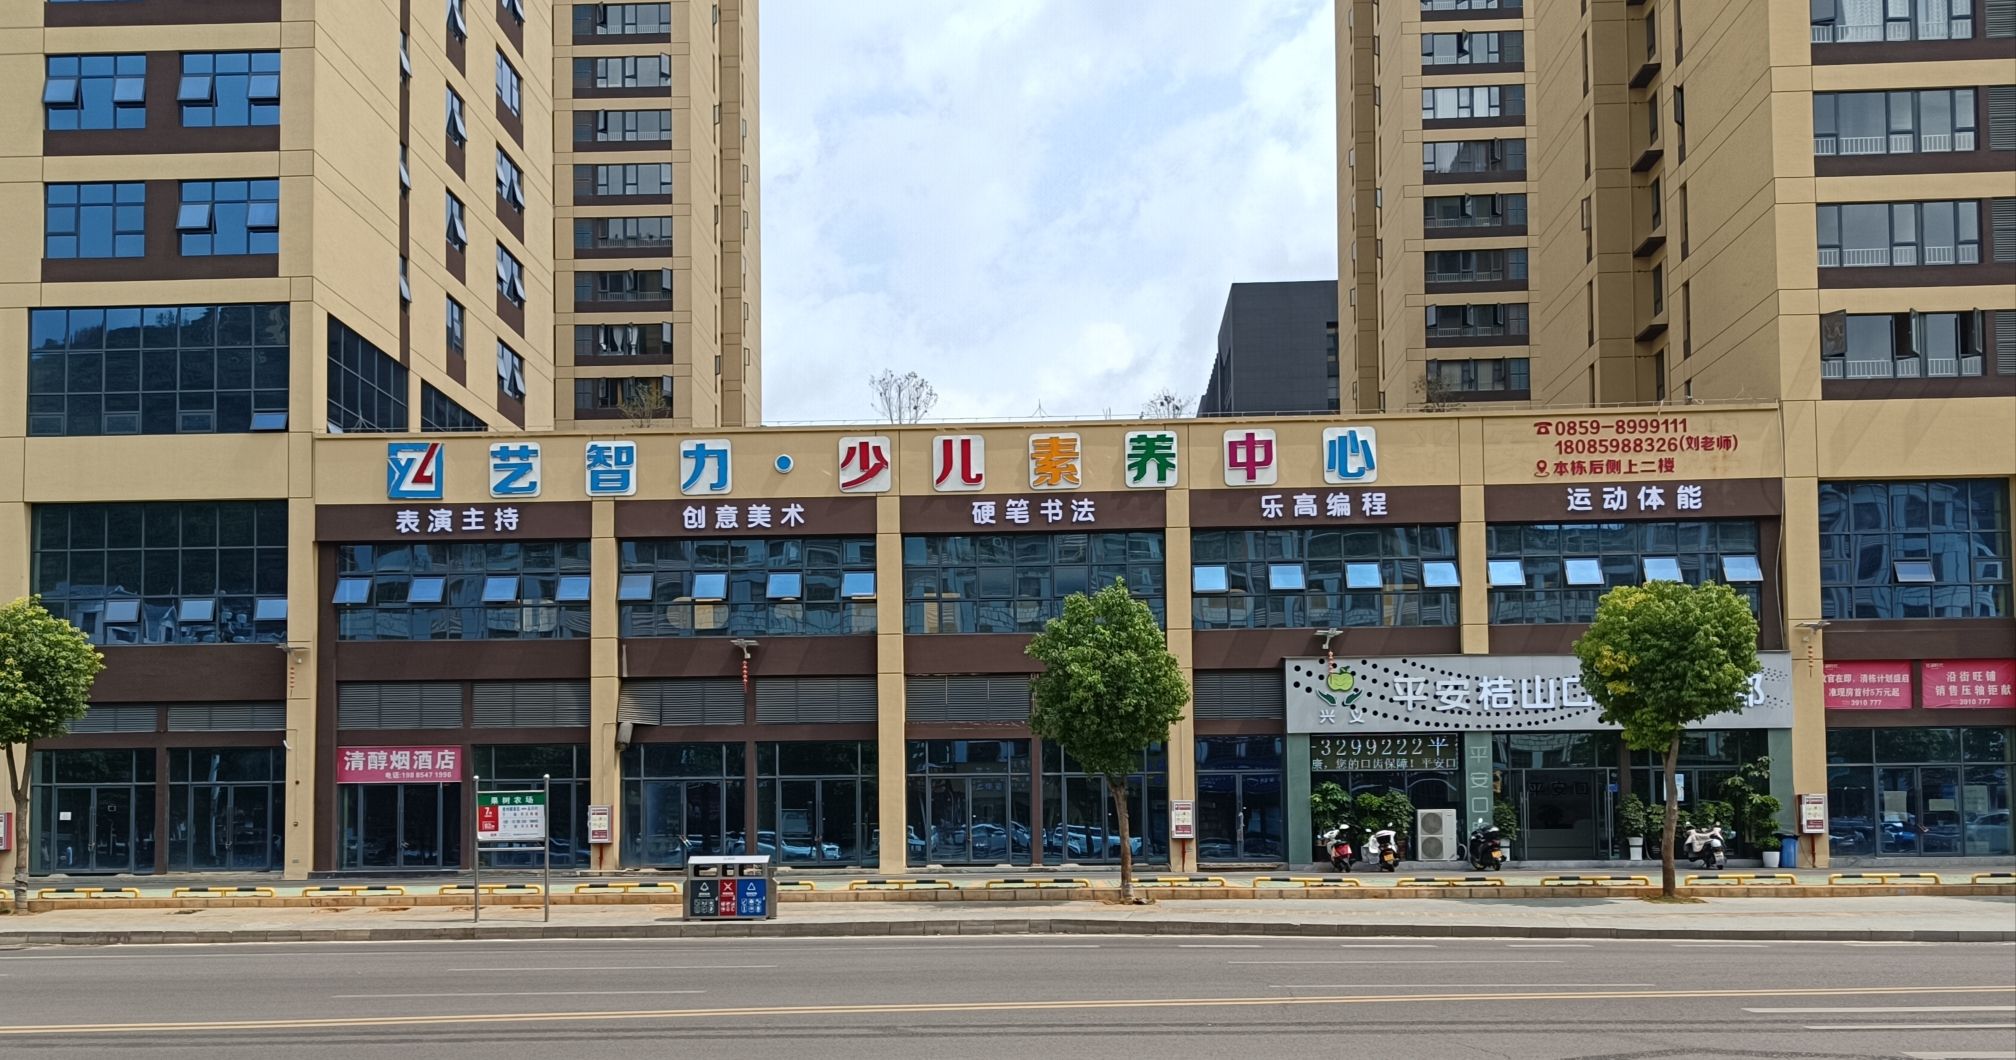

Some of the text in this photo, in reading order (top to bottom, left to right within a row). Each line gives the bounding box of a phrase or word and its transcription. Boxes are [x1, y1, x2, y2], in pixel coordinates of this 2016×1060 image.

[1555, 418, 1687, 436] 0859-8999111
[1553, 457, 1675, 476] 本栋后侧上二楼
[1260, 493, 1388, 519] 乐高编程
[1566, 485, 1703, 511] 运动体能
[395, 508, 519, 534] 表演主持
[682, 503, 805, 530] 创意美术
[972, 498, 1096, 525] 硬笔书法
[1946, 671, 1996, 683] 沿街旺铺
[1393, 674, 1765, 711] 平安桔山口部
[1319, 709, 1365, 725] 兴义
[344, 750, 456, 771] 清醇烟酒店
